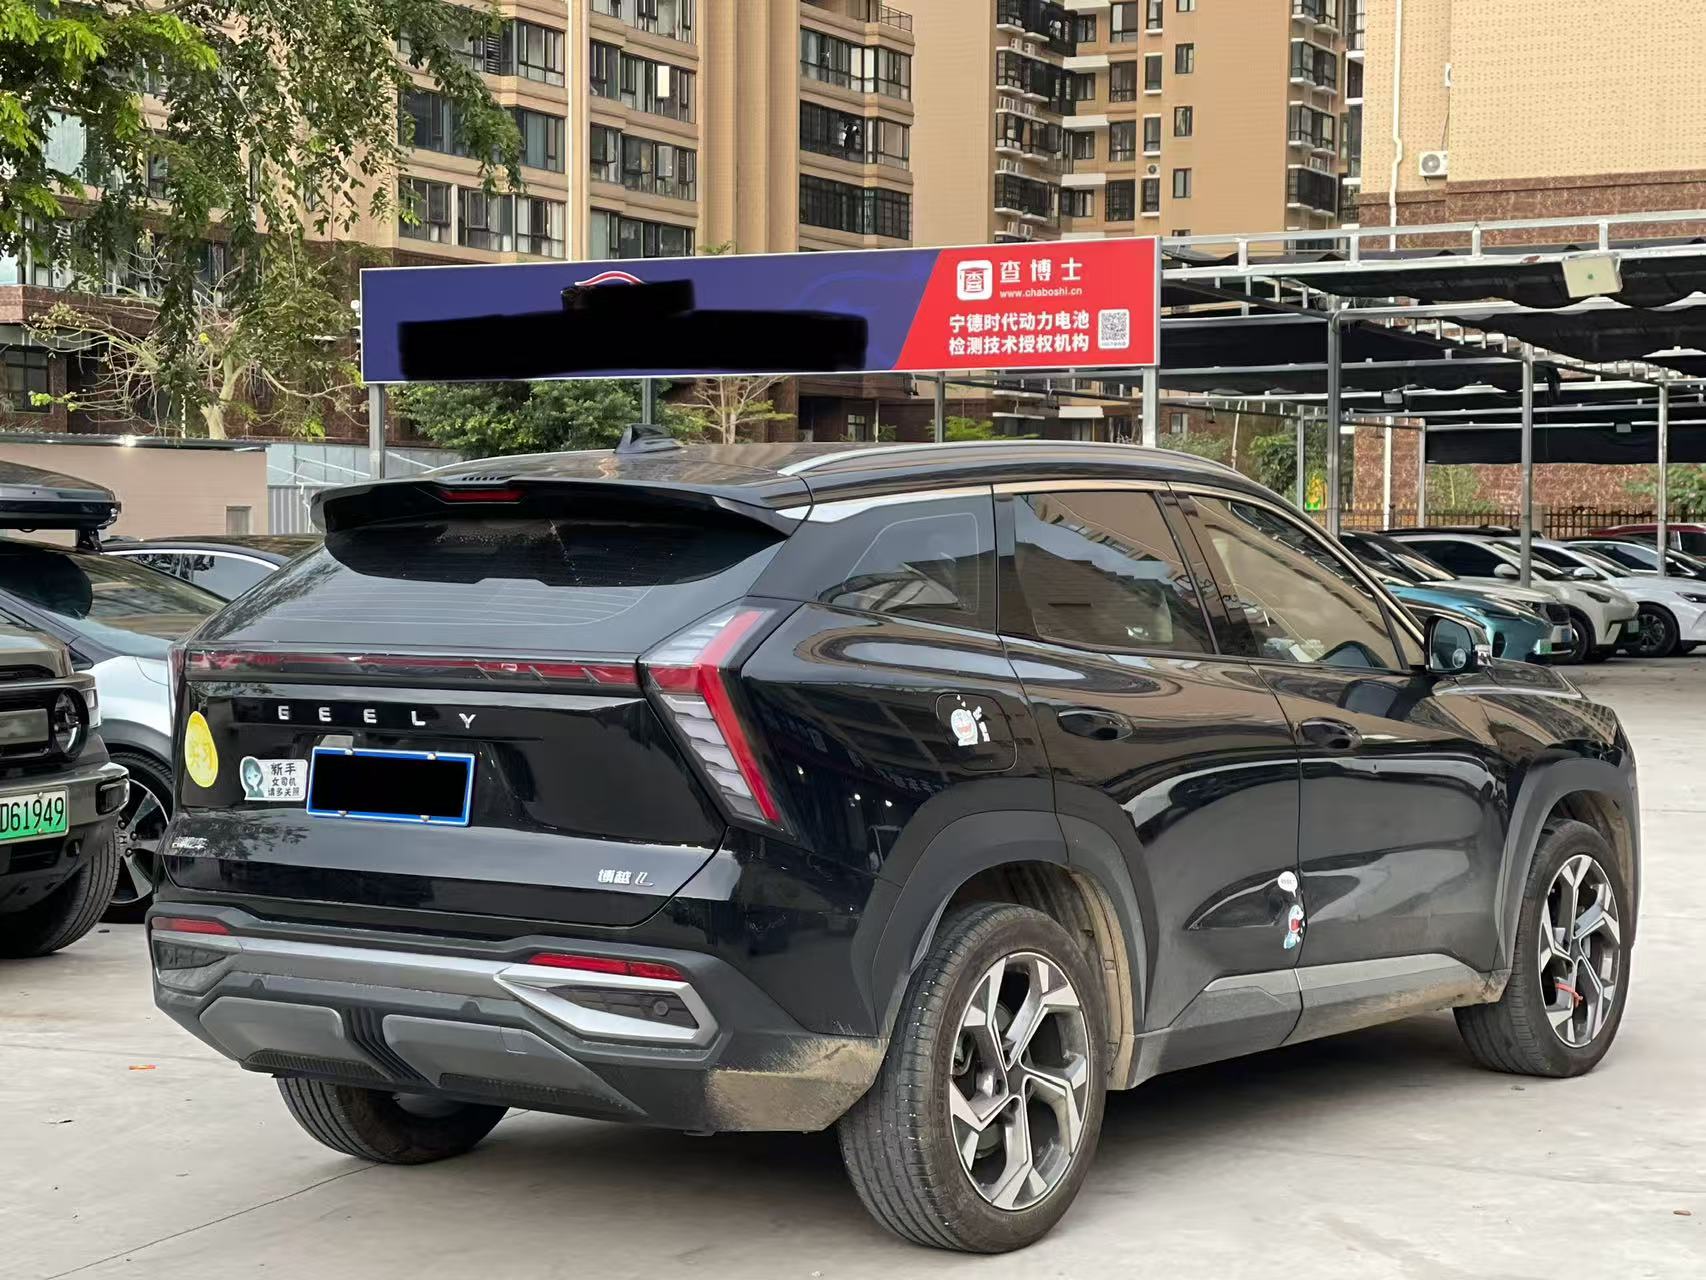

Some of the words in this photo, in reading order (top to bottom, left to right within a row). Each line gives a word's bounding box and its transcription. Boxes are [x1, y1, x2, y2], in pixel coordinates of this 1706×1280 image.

[1000, 257, 1082, 283] 查博士
[1000, 287, 1082, 298] www.chaboshi.cn
[949, 310, 1090, 333] 宁德时代动力电池
[949, 333, 1089, 356] 检测技术授权机构
[278, 705, 476, 729] GEELY
[270, 763, 296, 776] 新手
[272, 777, 296, 787] 女司机
[0, 796, 64, 833] D61949
